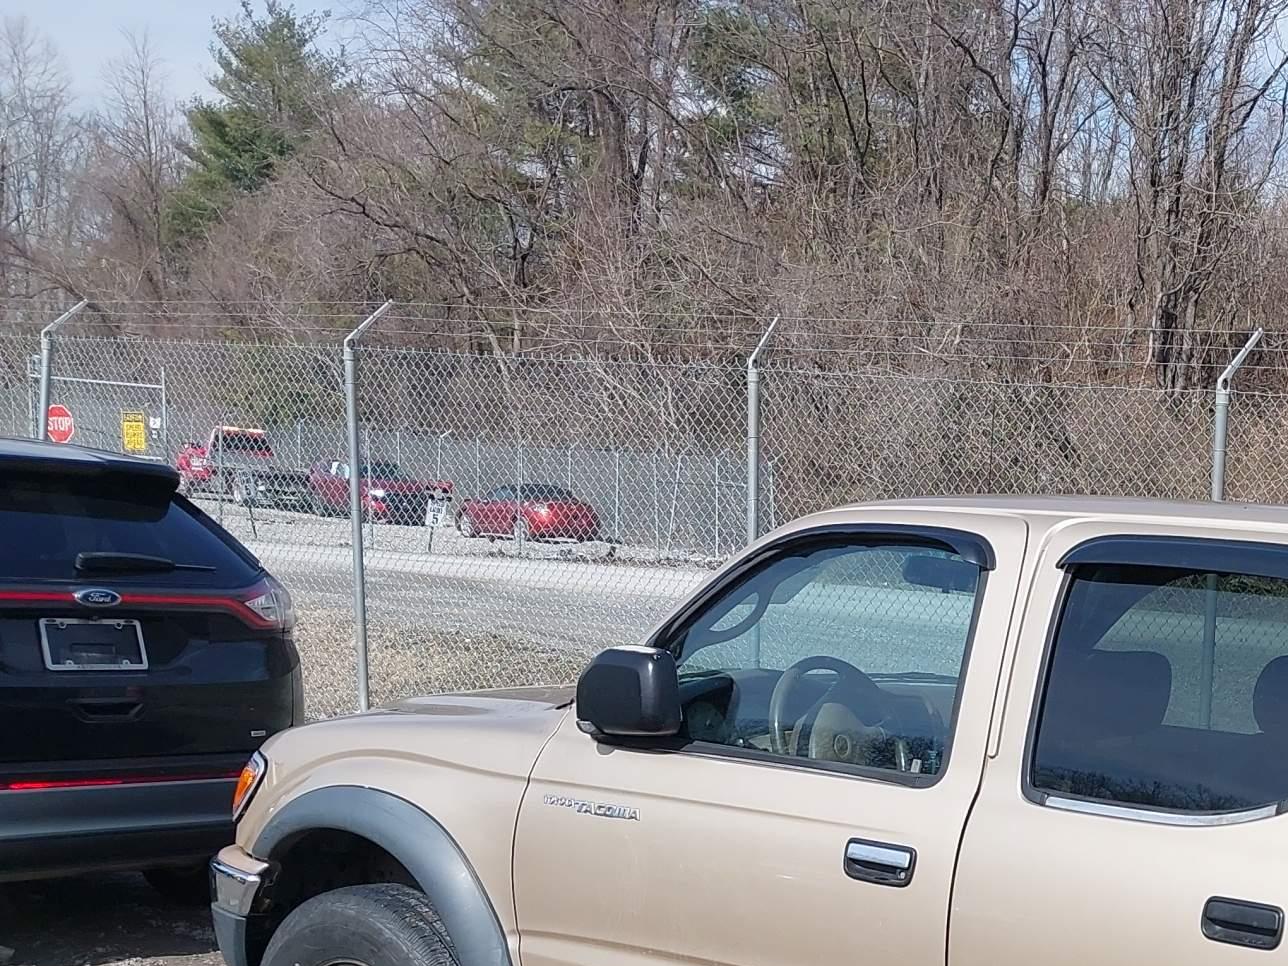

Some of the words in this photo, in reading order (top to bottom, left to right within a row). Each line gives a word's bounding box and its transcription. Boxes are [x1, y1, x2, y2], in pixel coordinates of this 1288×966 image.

[48, 417, 71, 431] STOP
[88, 593, 112, 603] Ford
[574, 799, 641, 821] TACOMA
